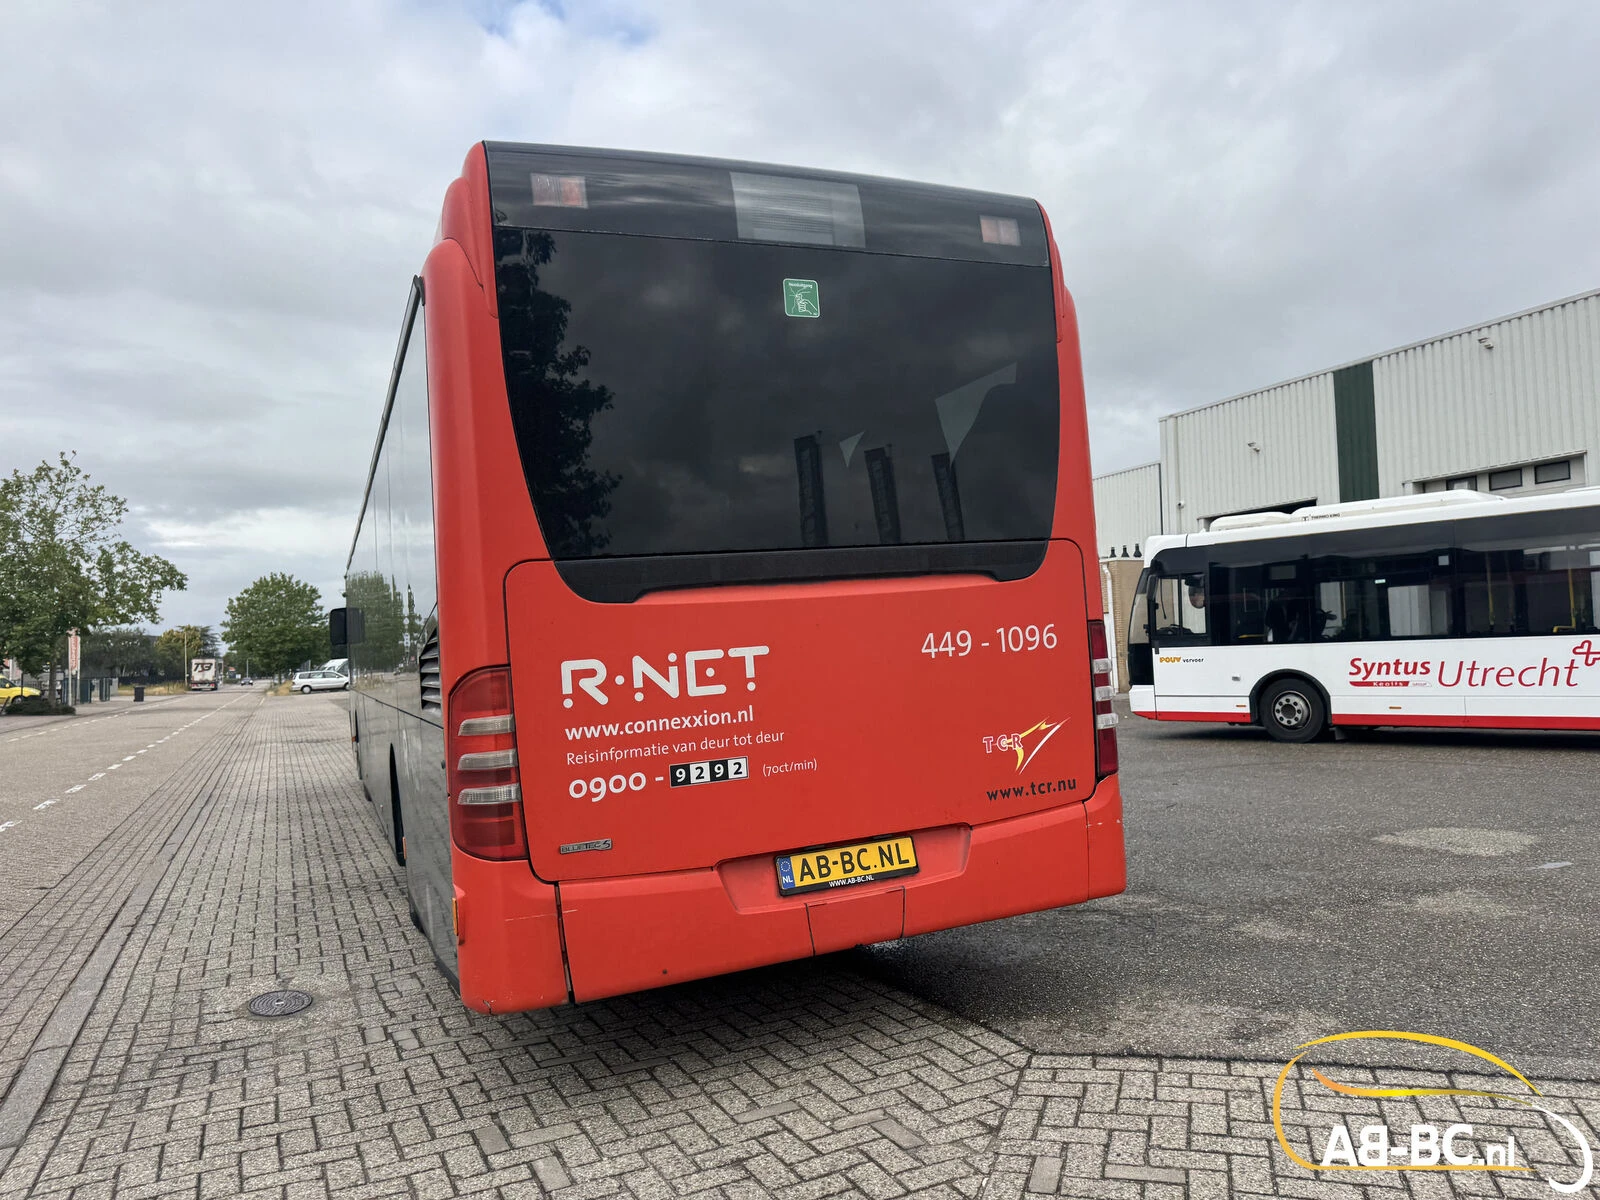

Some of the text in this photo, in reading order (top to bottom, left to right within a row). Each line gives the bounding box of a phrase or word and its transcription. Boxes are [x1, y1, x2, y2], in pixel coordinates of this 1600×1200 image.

[920, 629, 972, 659] 449
[996, 623, 1058, 653] 1096
[1348, 657, 1579, 688] Syntus Utrecht
[564, 705, 754, 741] www.connexxion.nl
[566, 730, 785, 765] Reisinformatie van deur tot deur
[982, 732, 1024, 754] TCR
[568, 771, 647, 803] 0900
[674, 760, 743, 783] 9292
[986, 778, 1077, 801] www.tcr.nu
[782, 842, 910, 884] NL AB-BC.NL
[828, 874, 875, 888] WWW.AB-BC.NL
